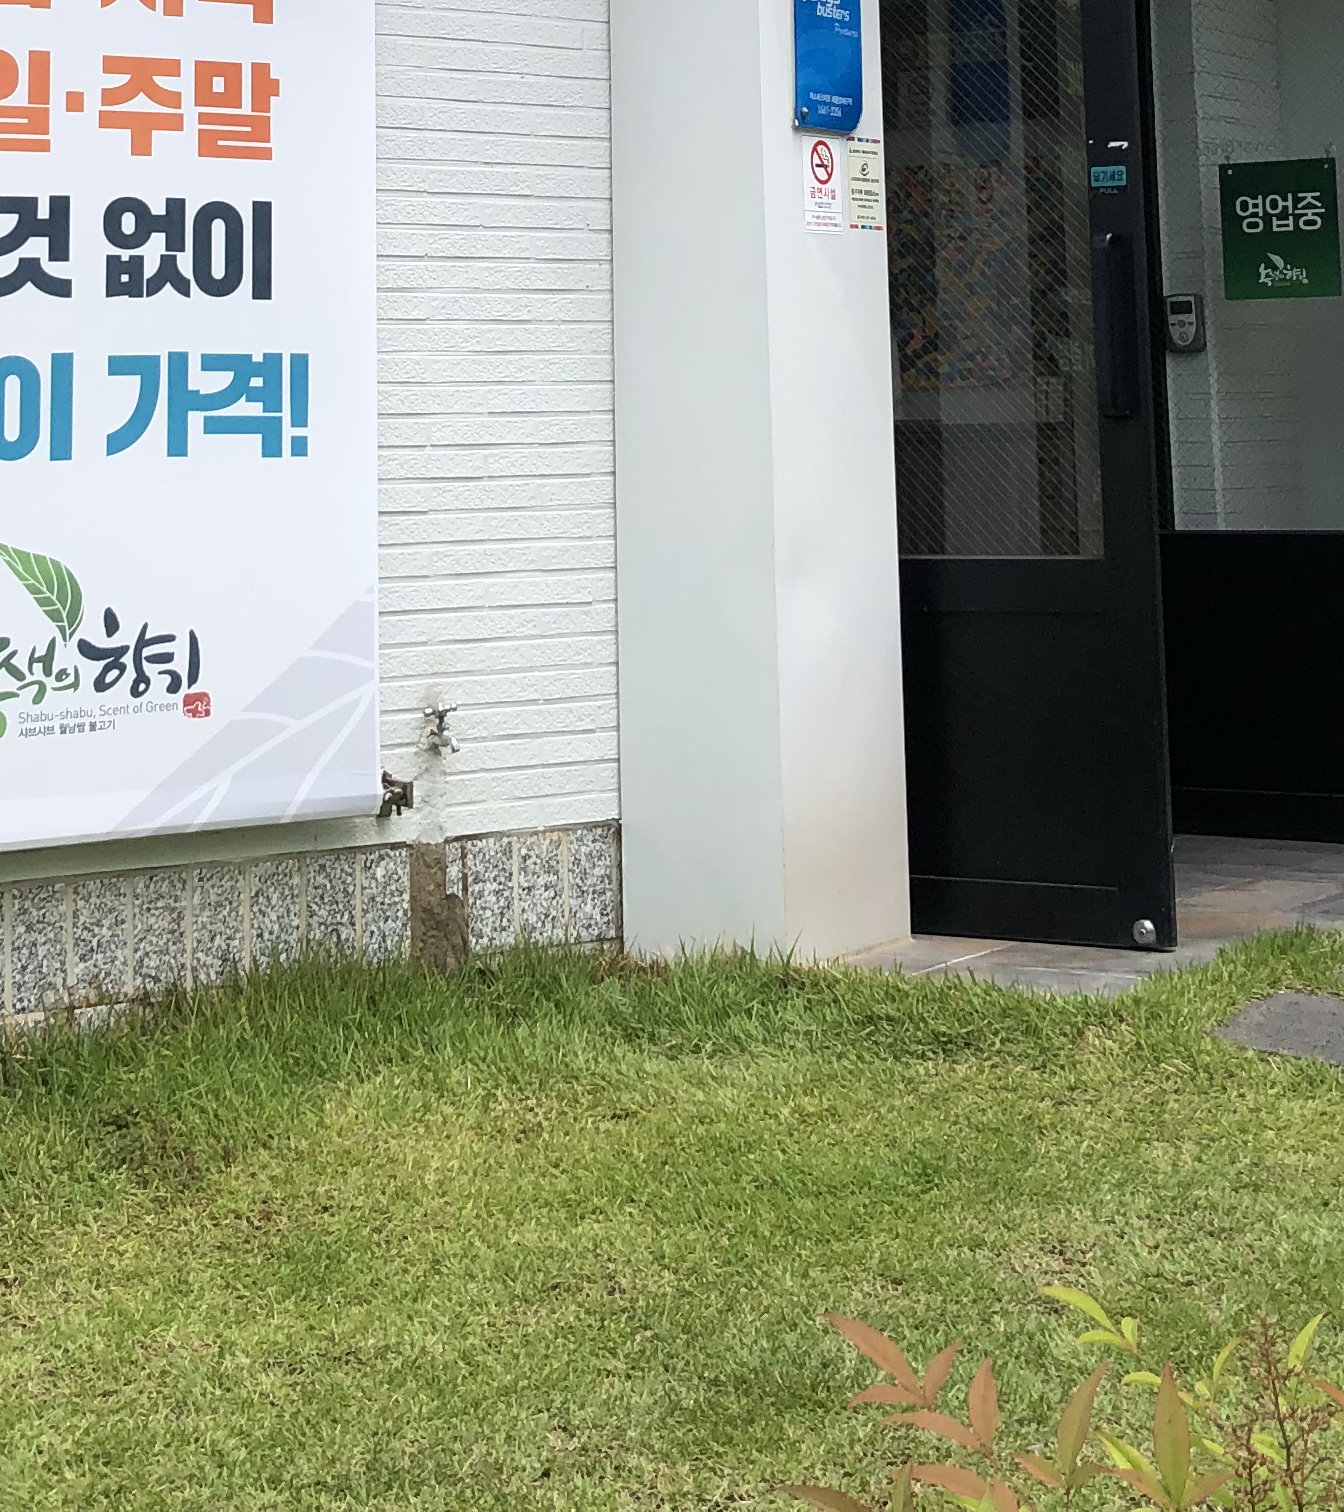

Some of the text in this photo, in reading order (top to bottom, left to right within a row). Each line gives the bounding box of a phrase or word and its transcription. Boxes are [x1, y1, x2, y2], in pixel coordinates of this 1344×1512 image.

[817, 2, 850, 21] busters
[1235, 192, 1325, 233] 영업중
[102, 196, 273, 300] 없이
[105, 351, 310, 459] 가격!
[18, 701, 179, 724] Shabu-shabu, Scent of Green
[18, 719, 116, 738] 샤브샤브 월남쌈 불고기
